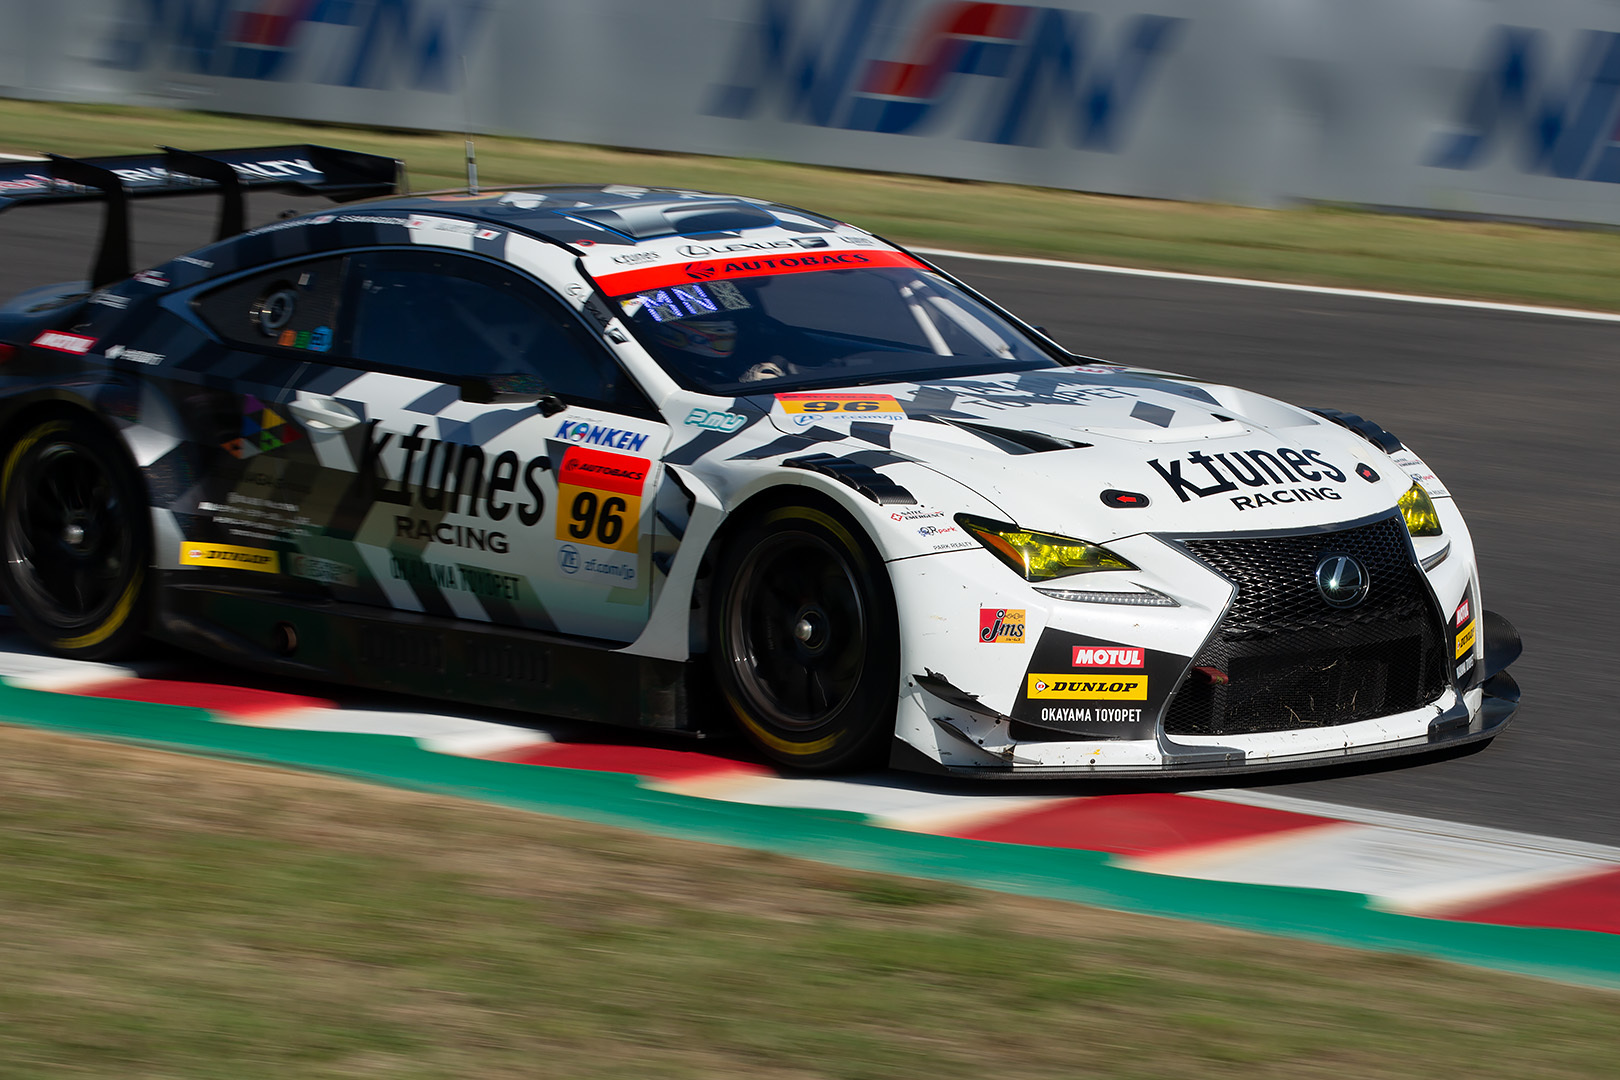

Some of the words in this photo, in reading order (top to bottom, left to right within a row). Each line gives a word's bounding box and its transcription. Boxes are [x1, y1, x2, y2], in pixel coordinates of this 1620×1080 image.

[709, 241, 794, 253] LEXUS
[725, 254, 870, 272] AUTOBACS
[803, 401, 880, 412] 96
[361, 419, 552, 526] ktunes
[578, 462, 644, 481] AUTOBACS
[1147, 448, 1347, 503] ktunes
[1230, 488, 1342, 511] RACING
[569, 491, 627, 545] 96
[394, 515, 510, 554] RACING
[584, 558, 636, 580] zf.com/jp
[1076, 649, 1141, 665] MOTUL
[1051, 681, 1138, 692] DUNLOP
[1041, 708, 1091, 721] OKAYAMA
[1095, 708, 1142, 722] TOYOPET
